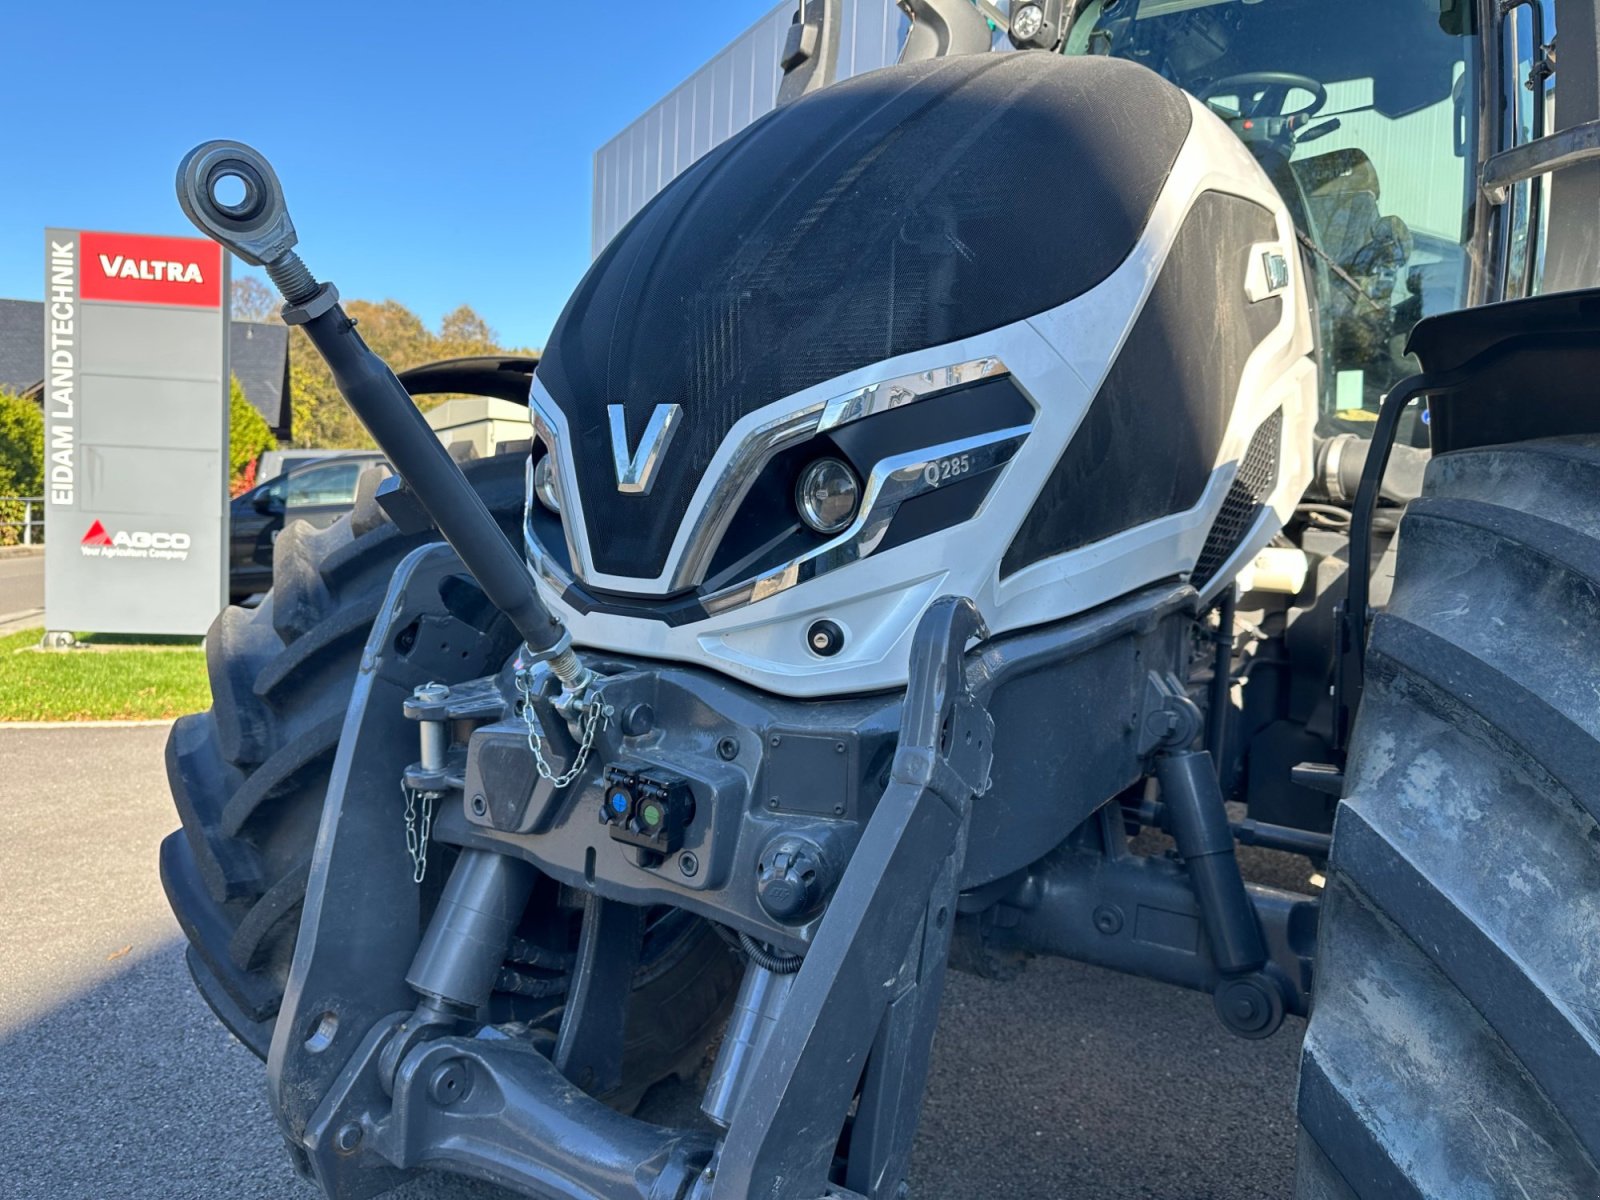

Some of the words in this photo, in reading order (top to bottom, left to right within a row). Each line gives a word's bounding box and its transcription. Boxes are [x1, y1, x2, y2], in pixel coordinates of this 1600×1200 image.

[98, 254, 204, 284] VALTRA
[51, 241, 74, 418] LANDTECHNIK
[51, 425, 74, 505] EIDAM
[113, 531, 191, 549] AGCO
[149, 549, 188, 561] Company
